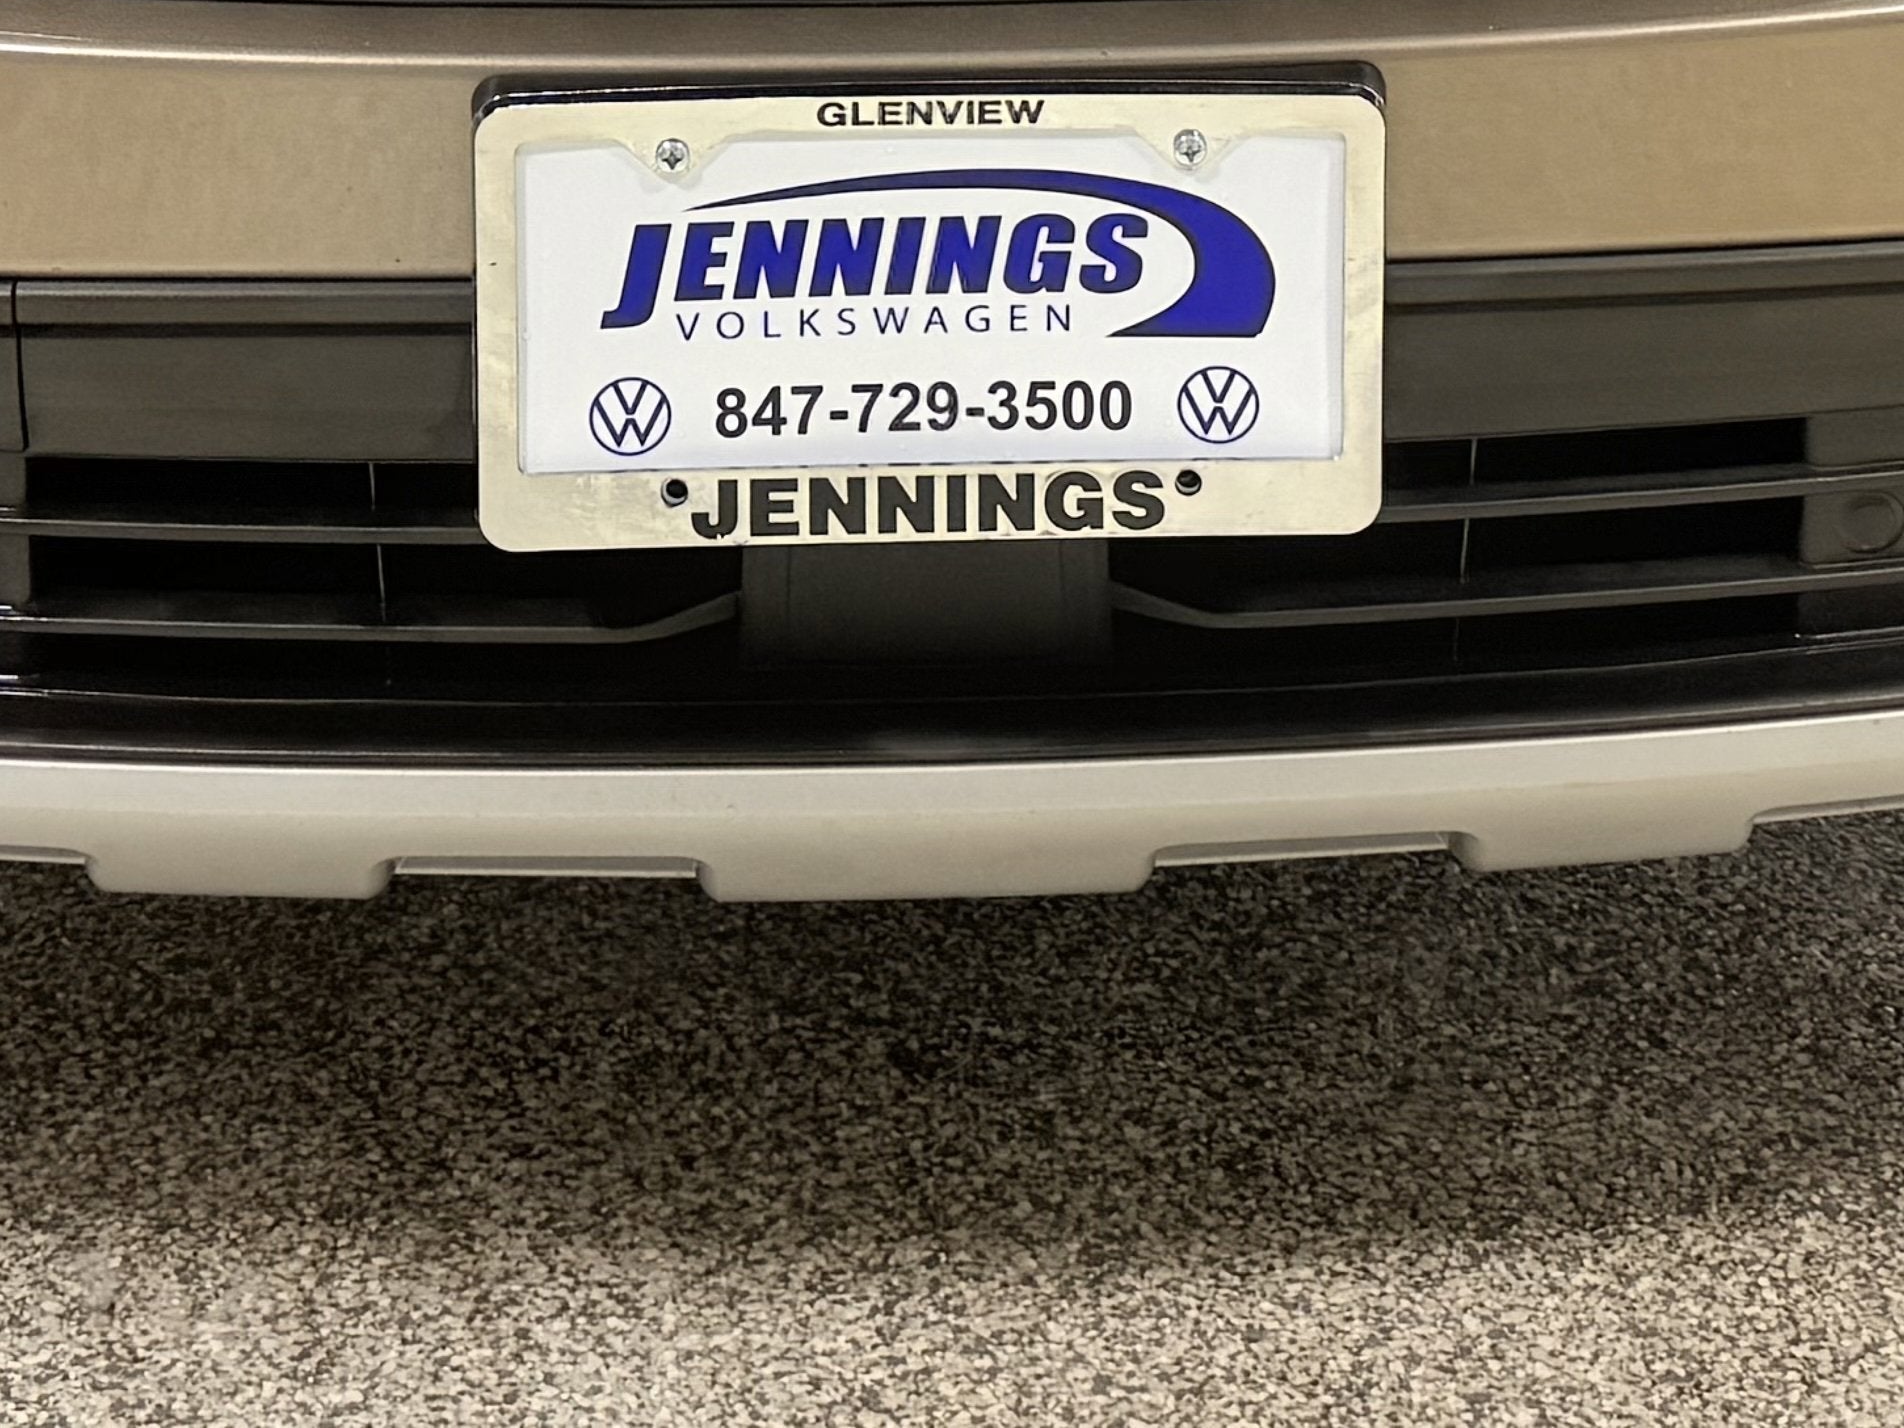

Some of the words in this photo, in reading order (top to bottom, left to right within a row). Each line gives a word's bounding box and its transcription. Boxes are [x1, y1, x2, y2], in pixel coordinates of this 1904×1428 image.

[816, 99, 1046, 127] GLENVIEW
[599, 212, 1150, 331] JENNINGS
[675, 303, 1071, 341] VOLKSWAGEN
[714, 379, 1133, 439] 847-729-3500
[690, 469, 1166, 540] JENNINGS
